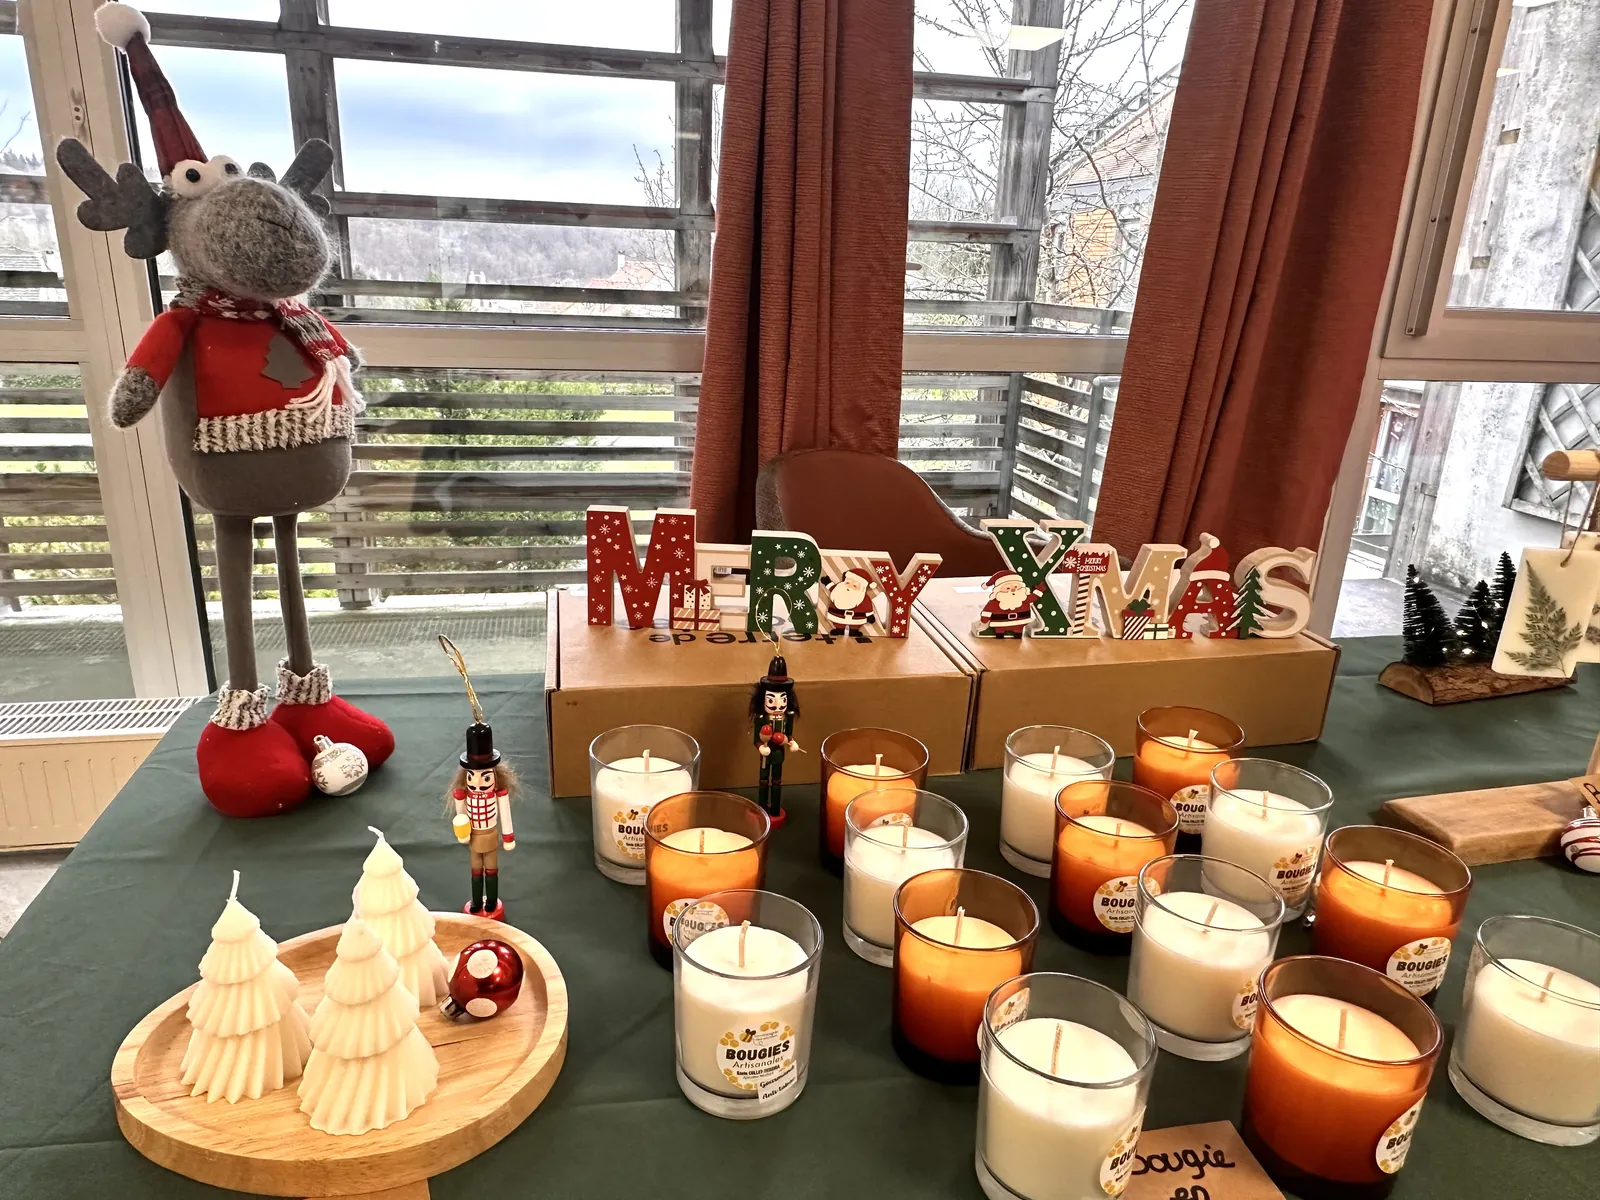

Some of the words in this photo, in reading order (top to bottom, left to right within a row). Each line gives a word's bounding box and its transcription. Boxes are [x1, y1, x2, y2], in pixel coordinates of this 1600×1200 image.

[971, 519, 1317, 640] XMAS
[1101, 897, 1136, 908] BOUG
[1396, 954, 1448, 971] BOUGIES
[726, 1040, 790, 1060] BOUGIES
